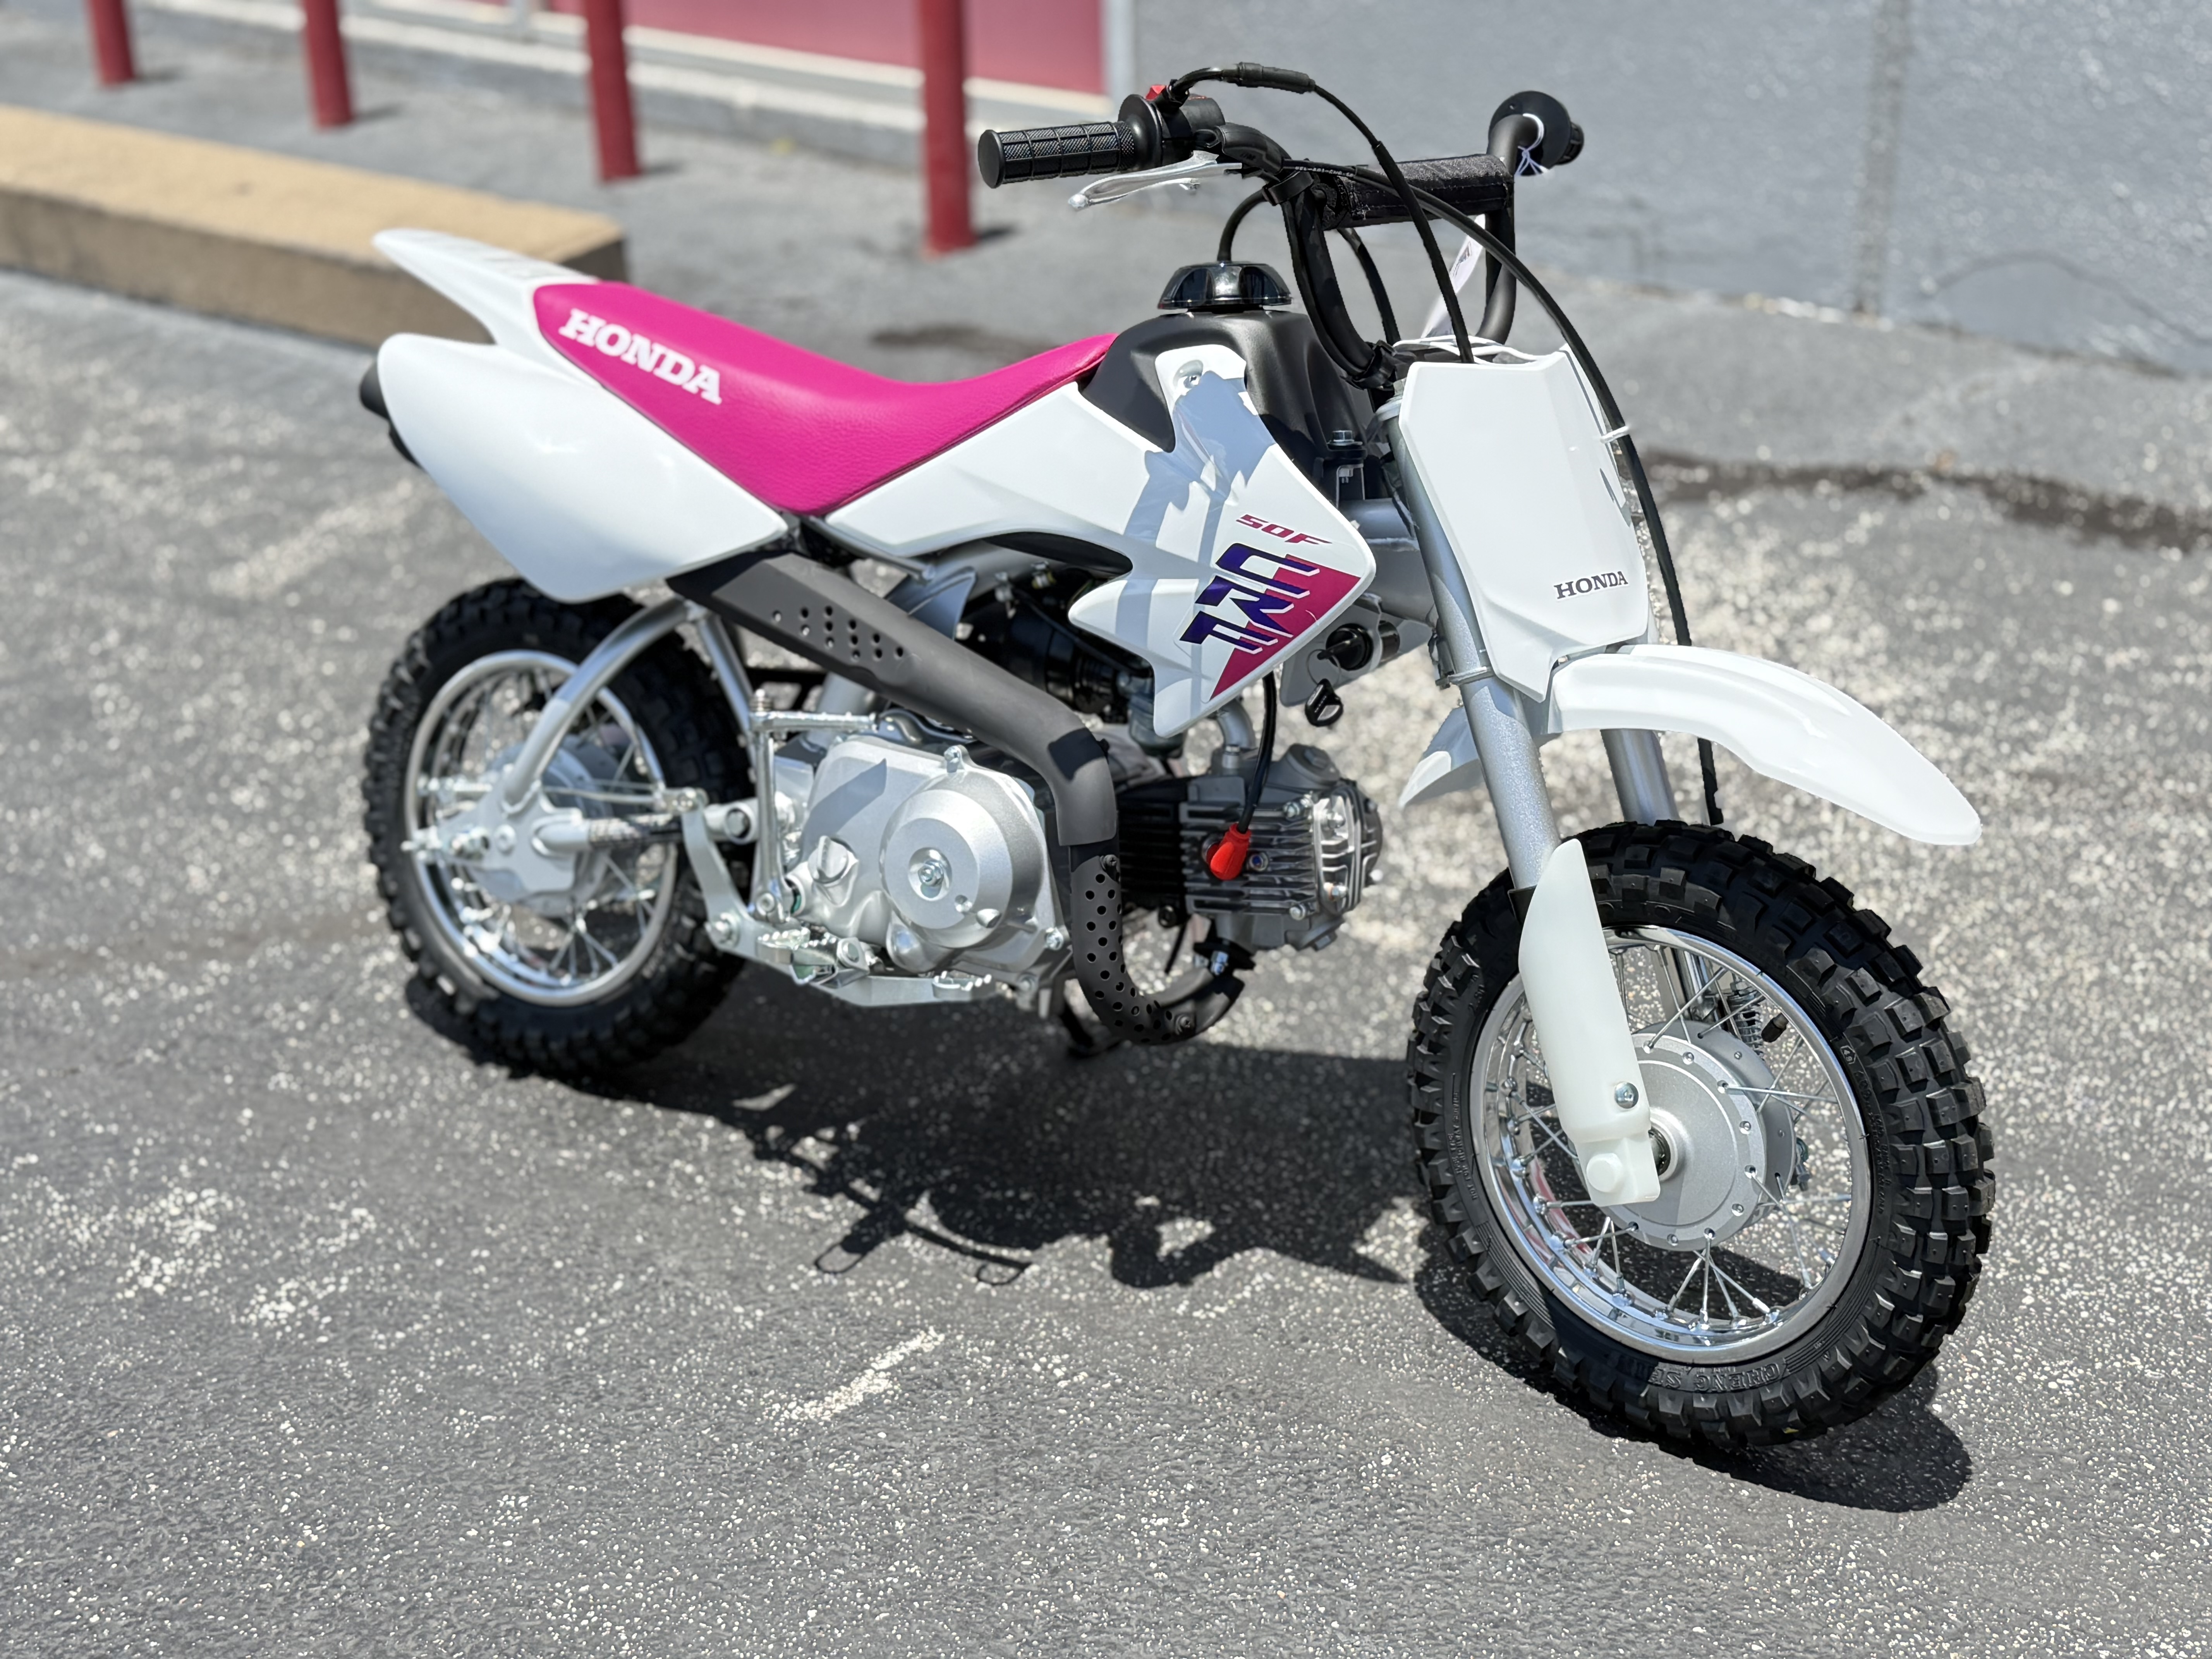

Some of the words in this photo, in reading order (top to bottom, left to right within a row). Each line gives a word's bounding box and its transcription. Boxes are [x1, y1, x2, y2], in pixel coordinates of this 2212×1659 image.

[559, 308, 722, 404] HONDA
[1236, 514, 1332, 544] 50F
[1179, 543, 1320, 654] CRF
[1554, 571, 1628, 599] HONDA
[1693, 1363, 1780, 1393] CHENG
